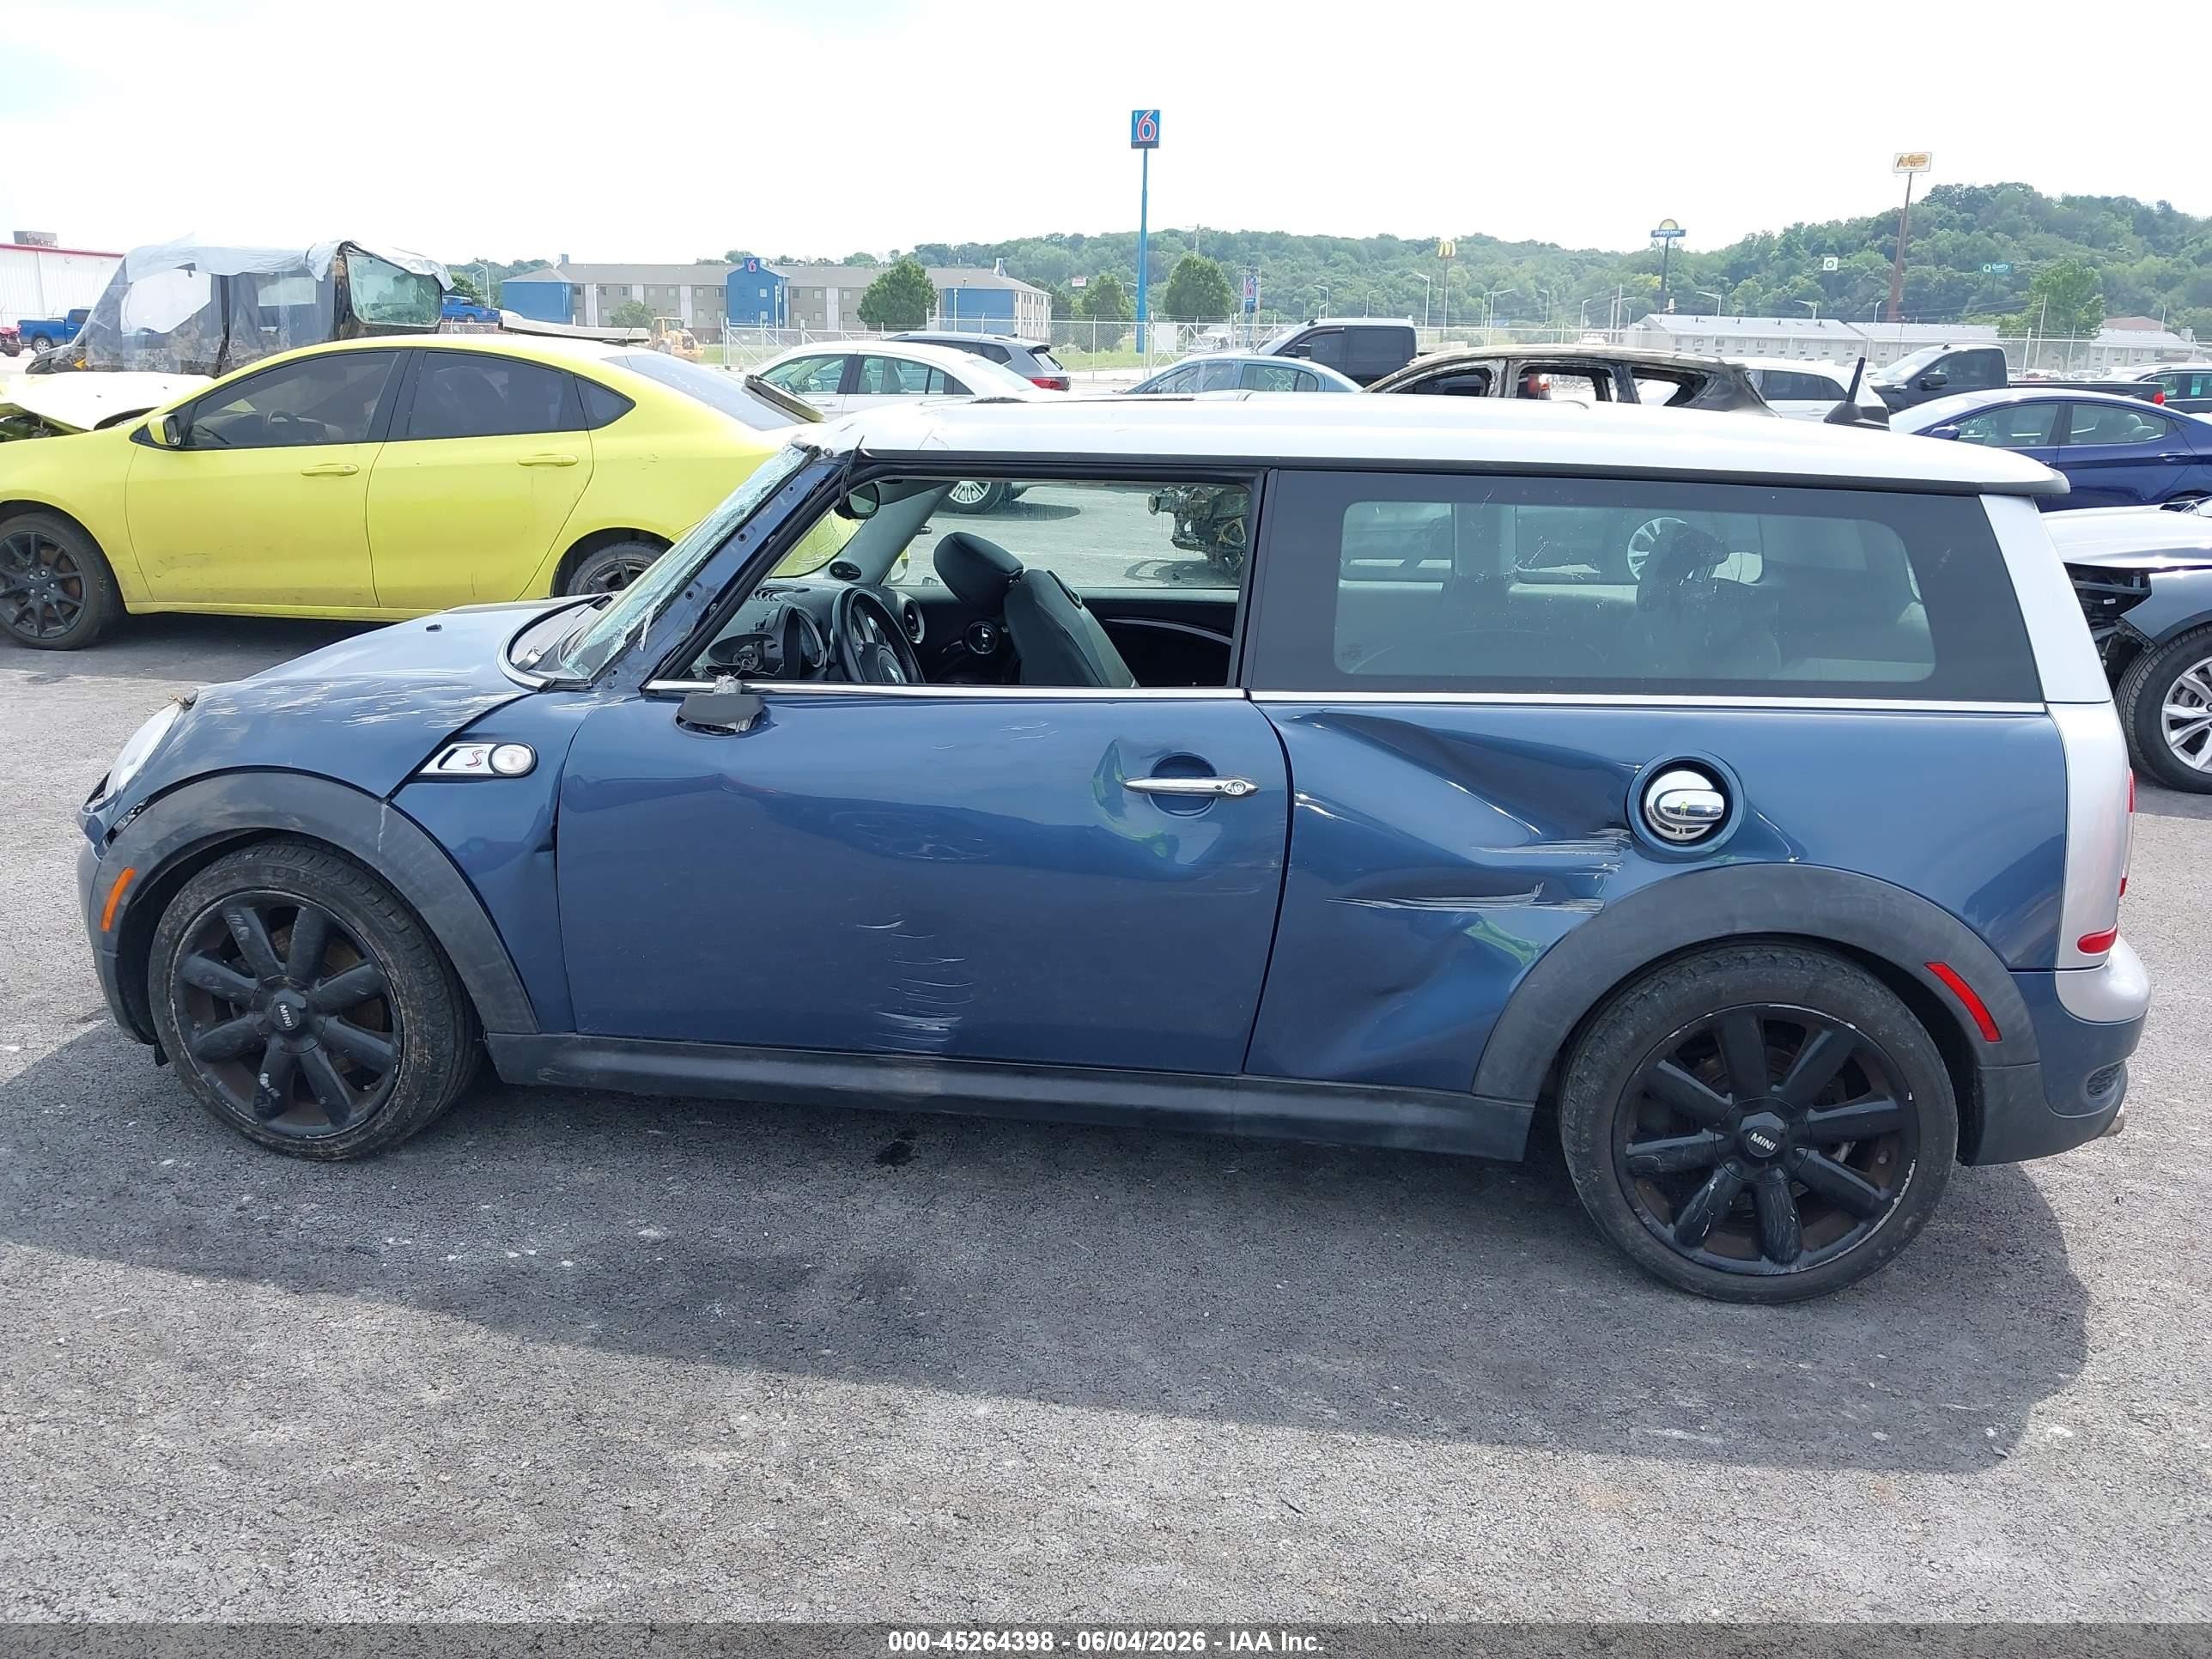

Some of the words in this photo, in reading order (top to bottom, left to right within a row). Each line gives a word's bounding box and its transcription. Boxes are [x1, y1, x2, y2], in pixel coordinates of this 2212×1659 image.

[1137, 110, 1157, 142] 6
[747, 259, 757, 272] 6
[465, 750, 487, 768] S
[279, 1005, 294, 1027] MINI
[1750, 1132, 1777, 1152] MINI
